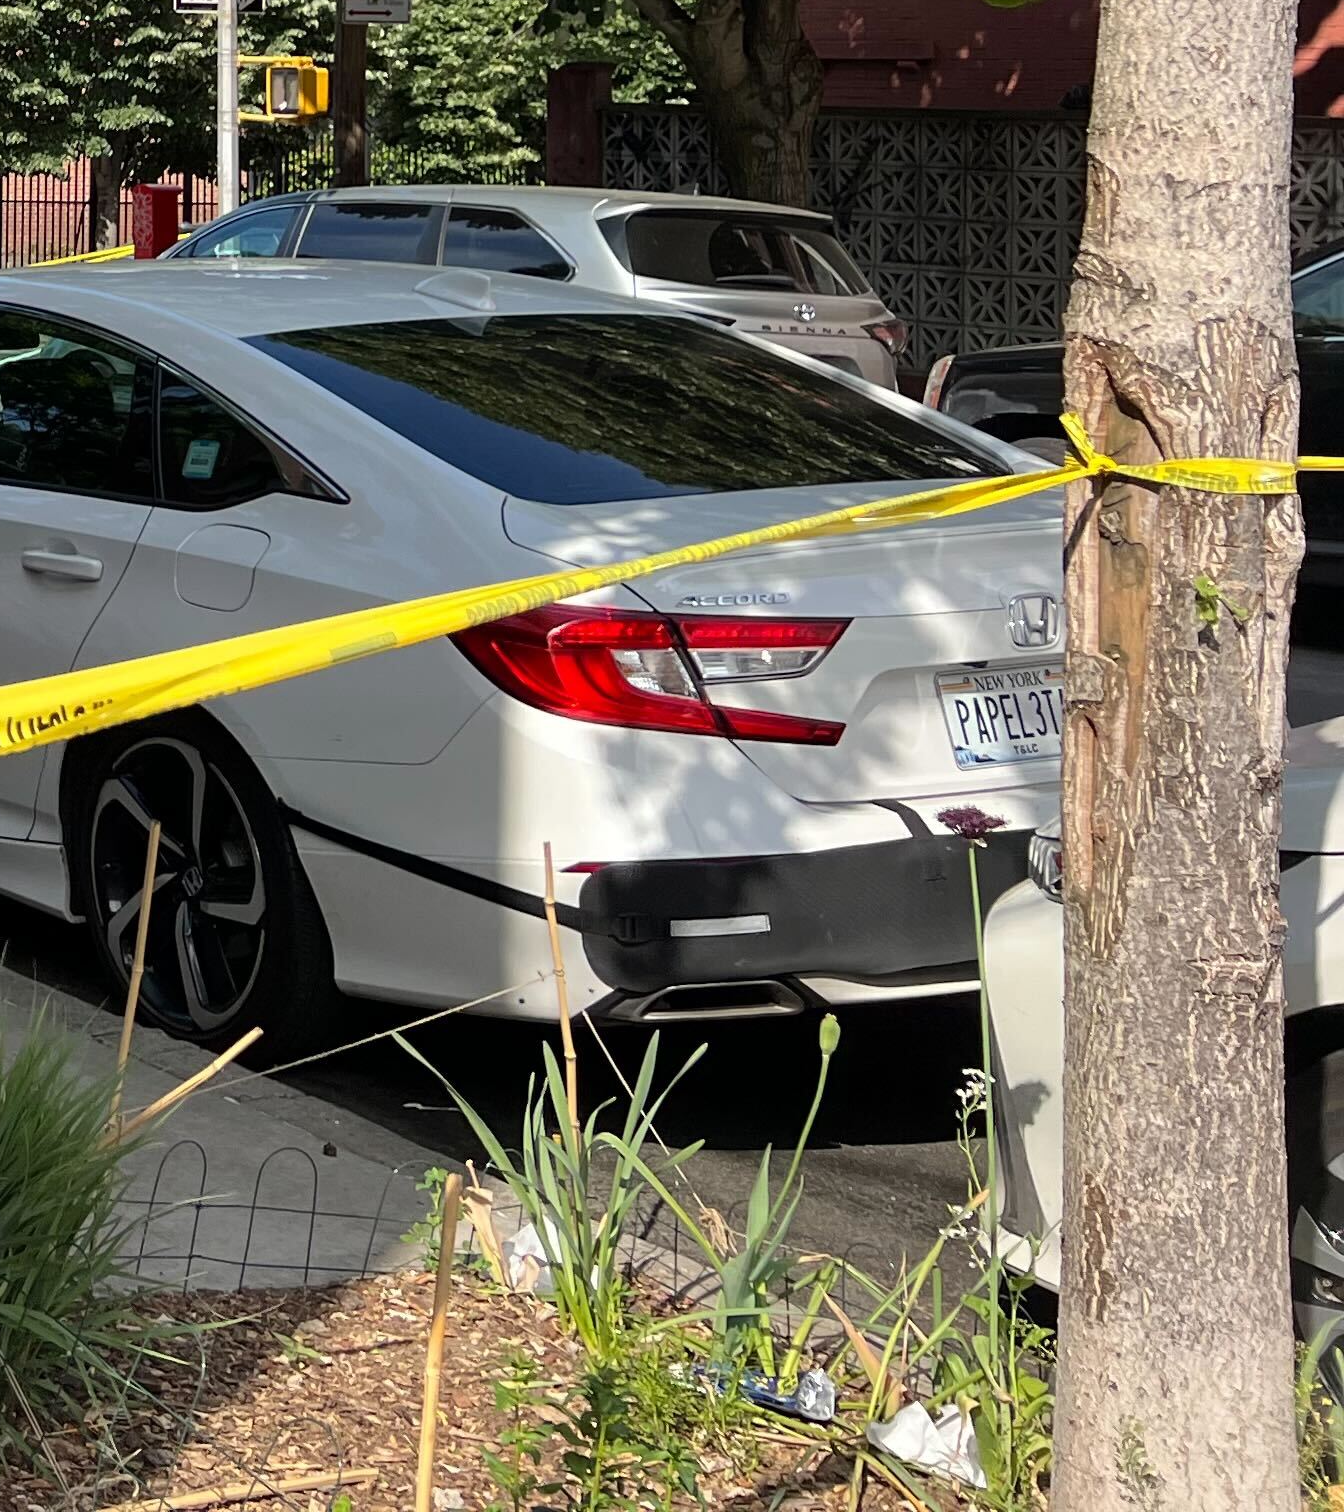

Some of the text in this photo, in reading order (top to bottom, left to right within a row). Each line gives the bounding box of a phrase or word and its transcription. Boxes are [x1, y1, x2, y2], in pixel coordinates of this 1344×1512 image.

[675, 591, 791, 608] ACCORD
[973, 669, 1044, 692] NEW YORK
[954, 688, 1064, 746] PAPEL3T
[1013, 743, 1040, 755] T&LC
